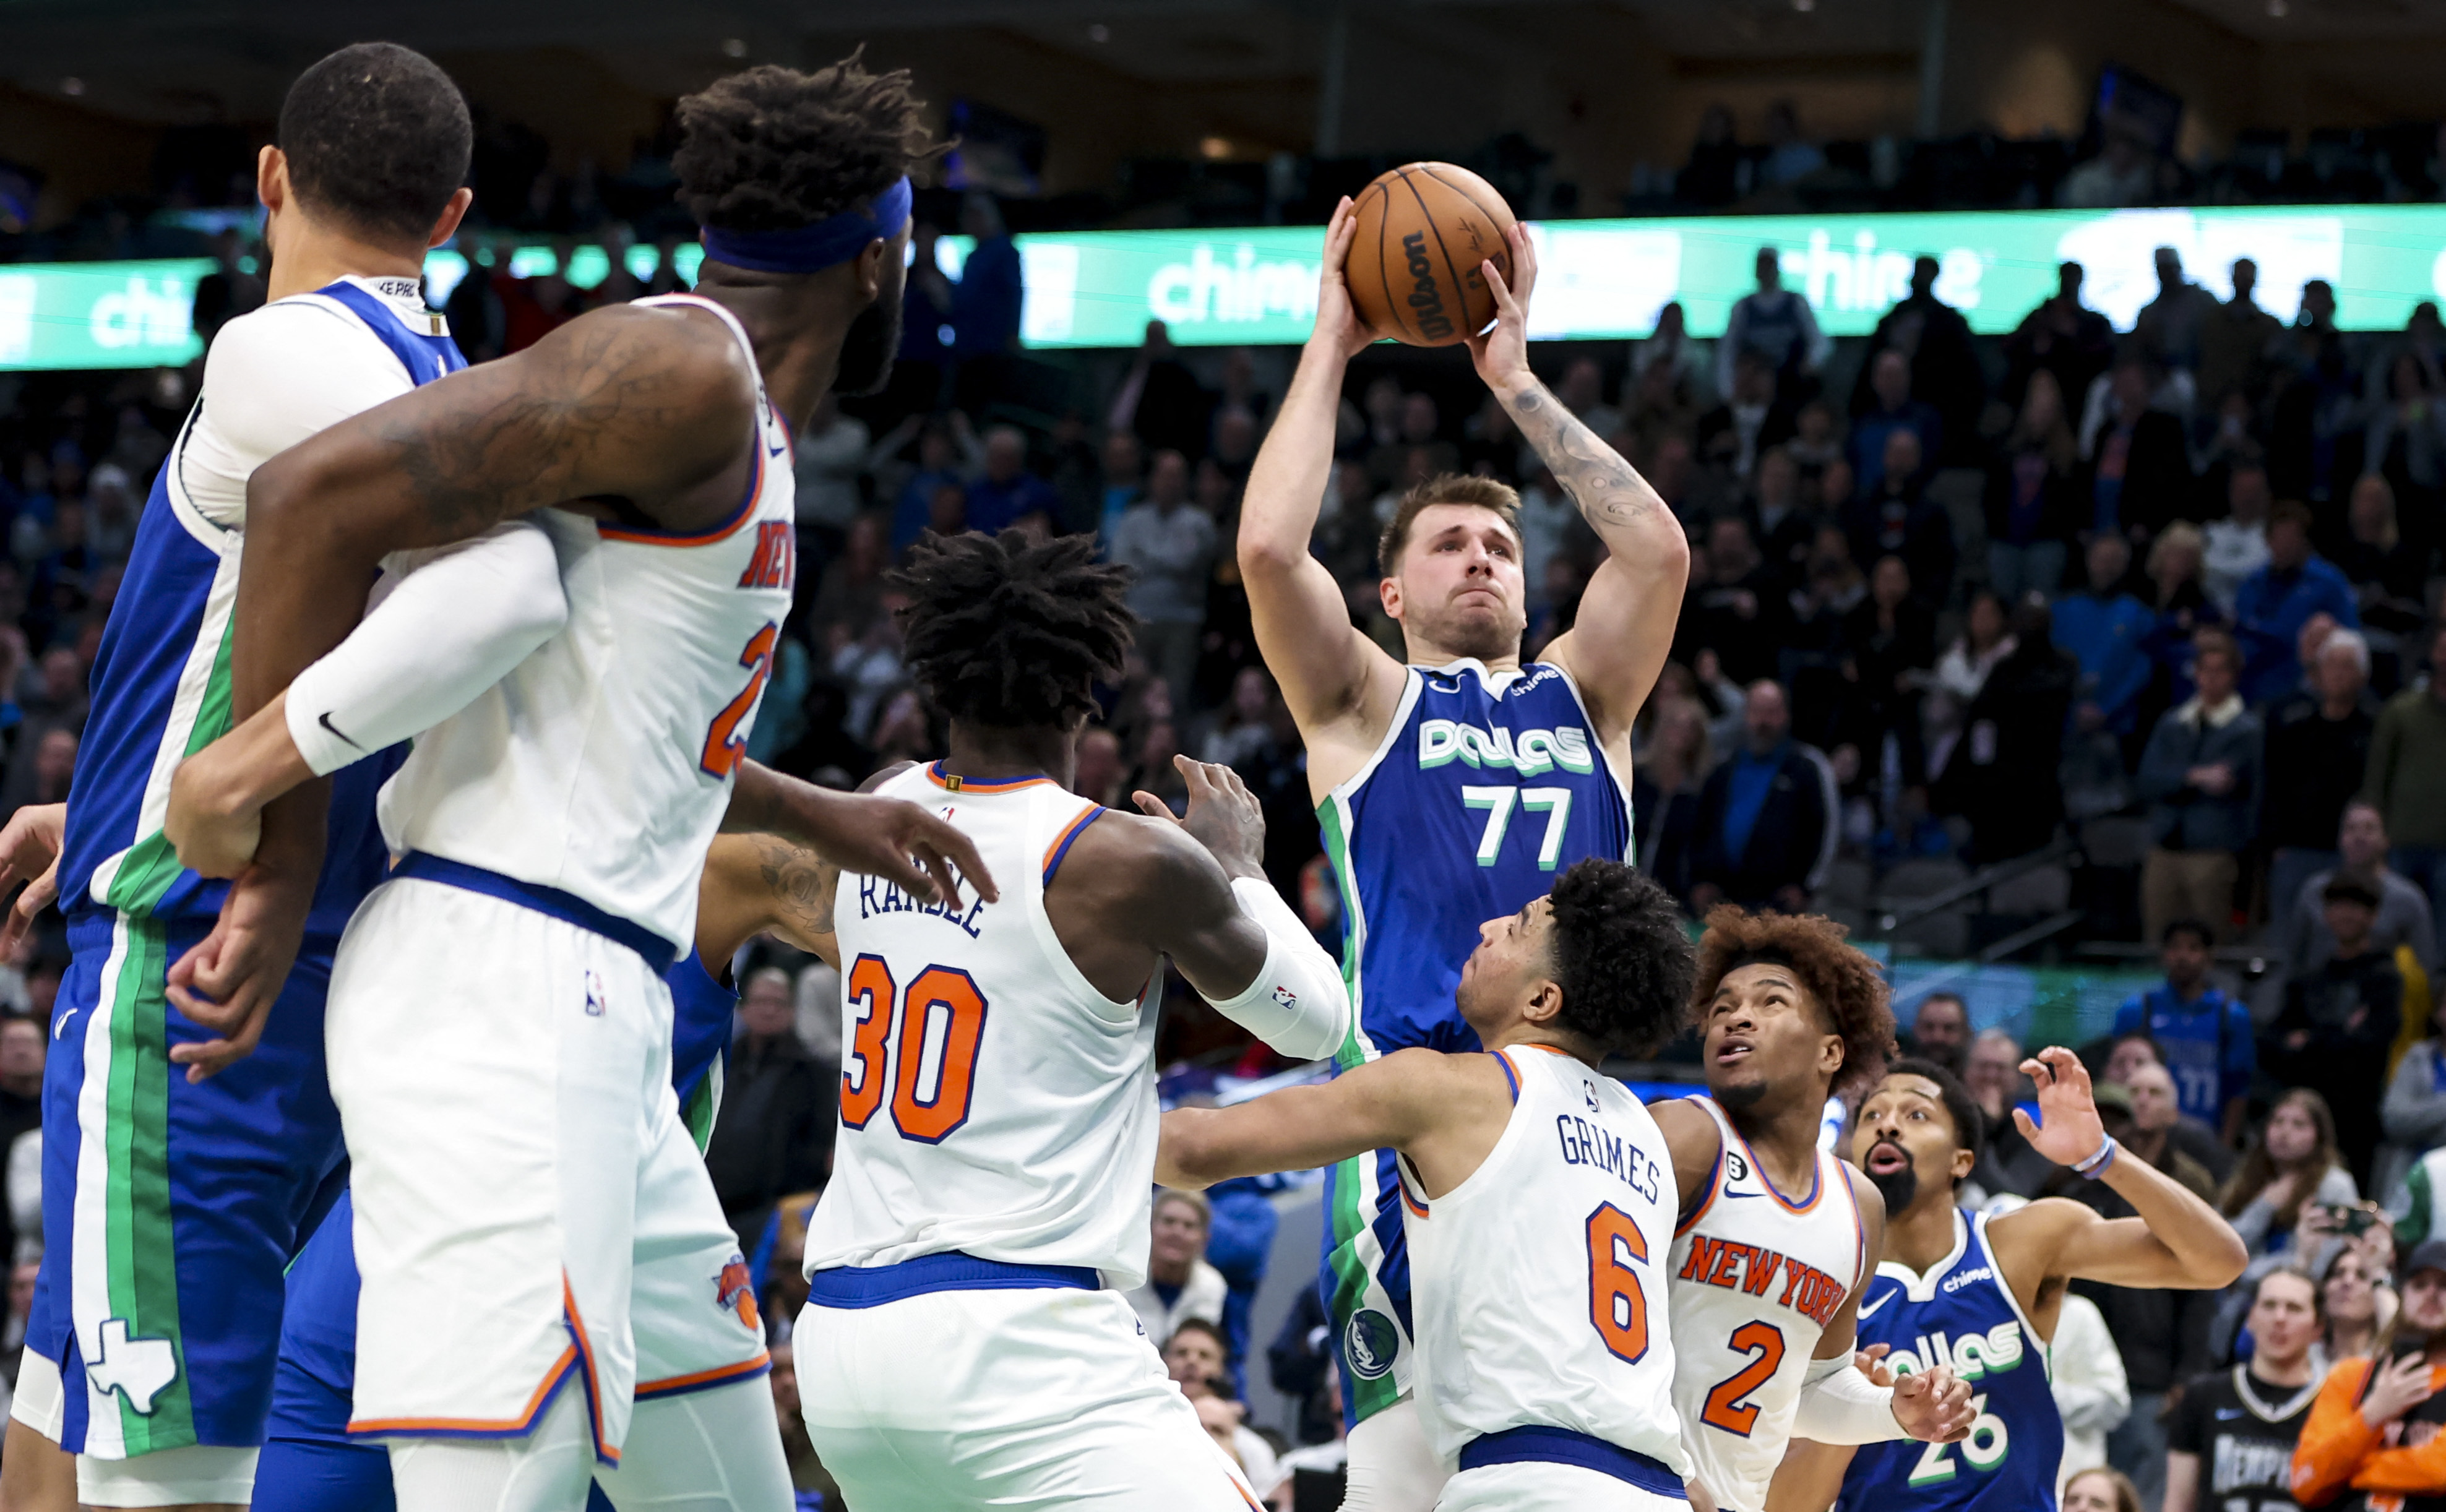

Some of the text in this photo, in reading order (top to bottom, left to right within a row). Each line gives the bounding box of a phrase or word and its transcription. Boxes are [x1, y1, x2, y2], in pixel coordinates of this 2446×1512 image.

[90, 272, 192, 348] chi
[1148, 242, 1322, 323] chim
[1402, 229, 1455, 341] Wilson
[700, 621, 778, 782] 2
[1510, 669, 1559, 697] chime
[1462, 785, 1572, 871] 77
[840, 953, 988, 1145] 30
[1556, 1114, 1660, 1206] GRIMES
[1586, 1200, 1649, 1366] 6
[1678, 1235, 1847, 1329] NEW YORK
[1943, 1266, 1992, 1293] chime
[1699, 1320, 1786, 1438] 2
[1873, 1320, 2023, 1380] allas
[1908, 1393, 2009, 1488] 26
